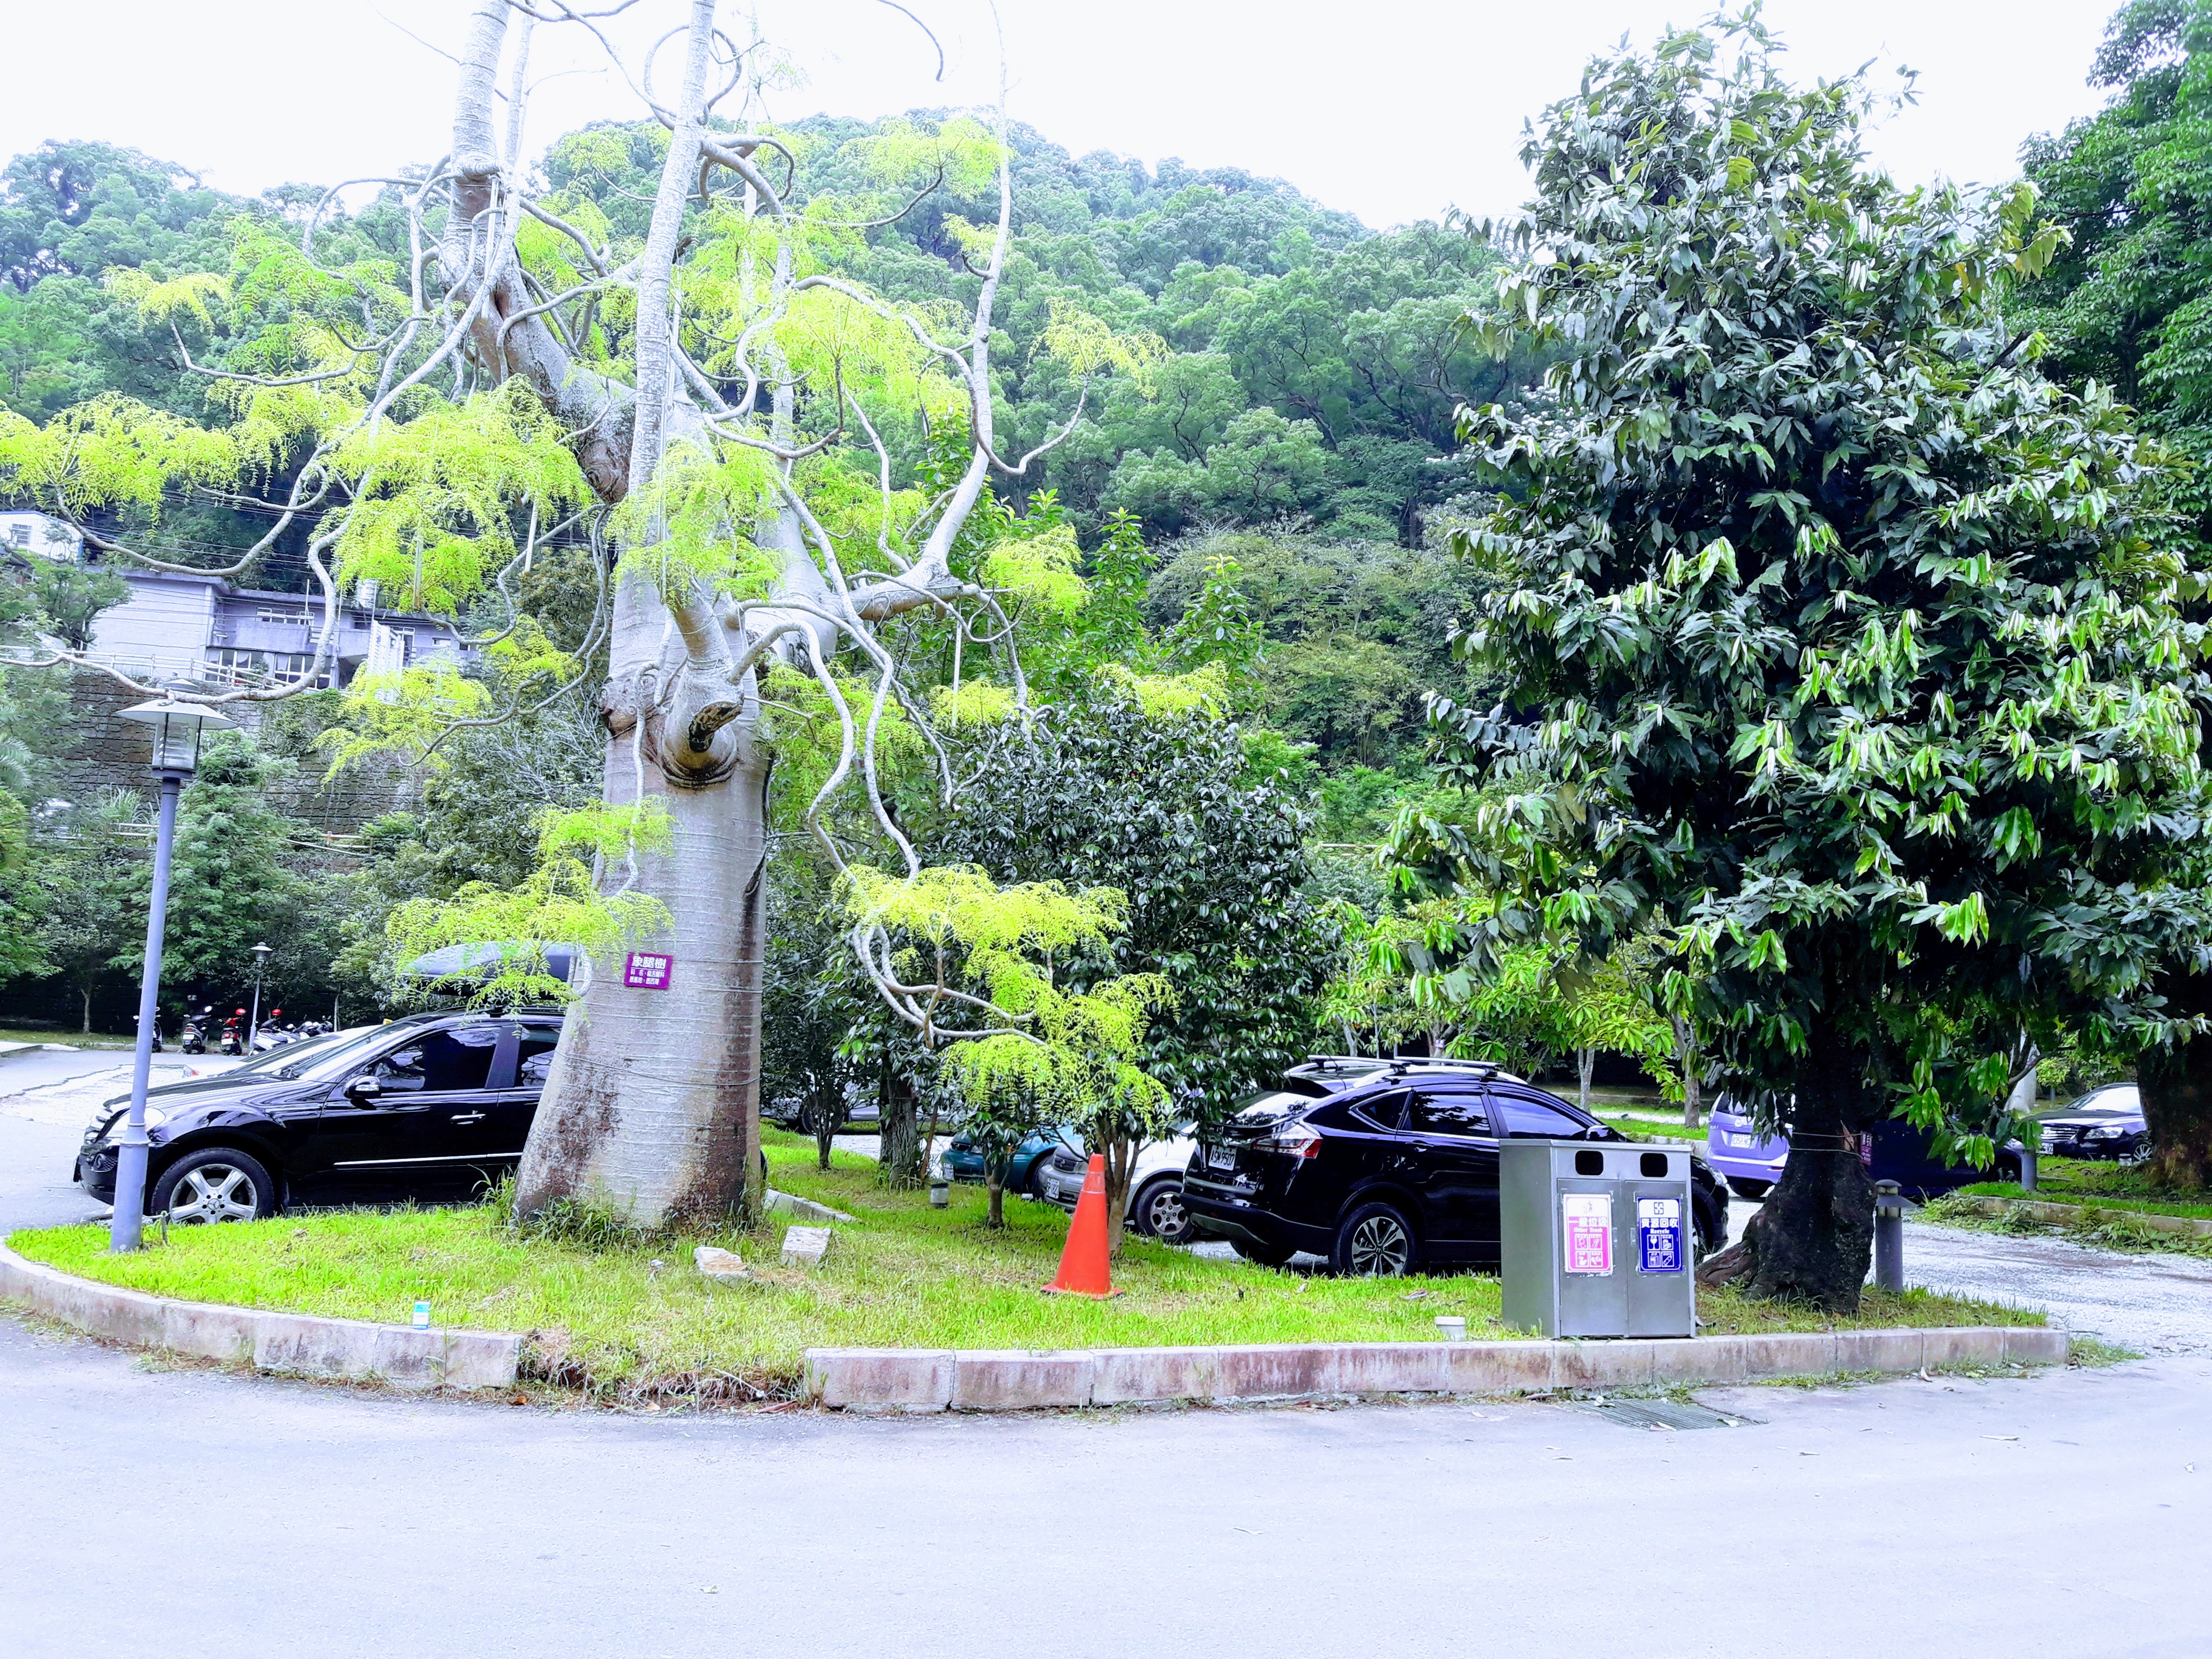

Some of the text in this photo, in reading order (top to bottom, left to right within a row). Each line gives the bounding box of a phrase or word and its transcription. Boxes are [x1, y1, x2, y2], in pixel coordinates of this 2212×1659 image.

[631, 955, 667, 969] 象腿樹
[1569, 1217, 1607, 1227] 一般垃圾
[1641, 1218, 1678, 1228] 資源回收
